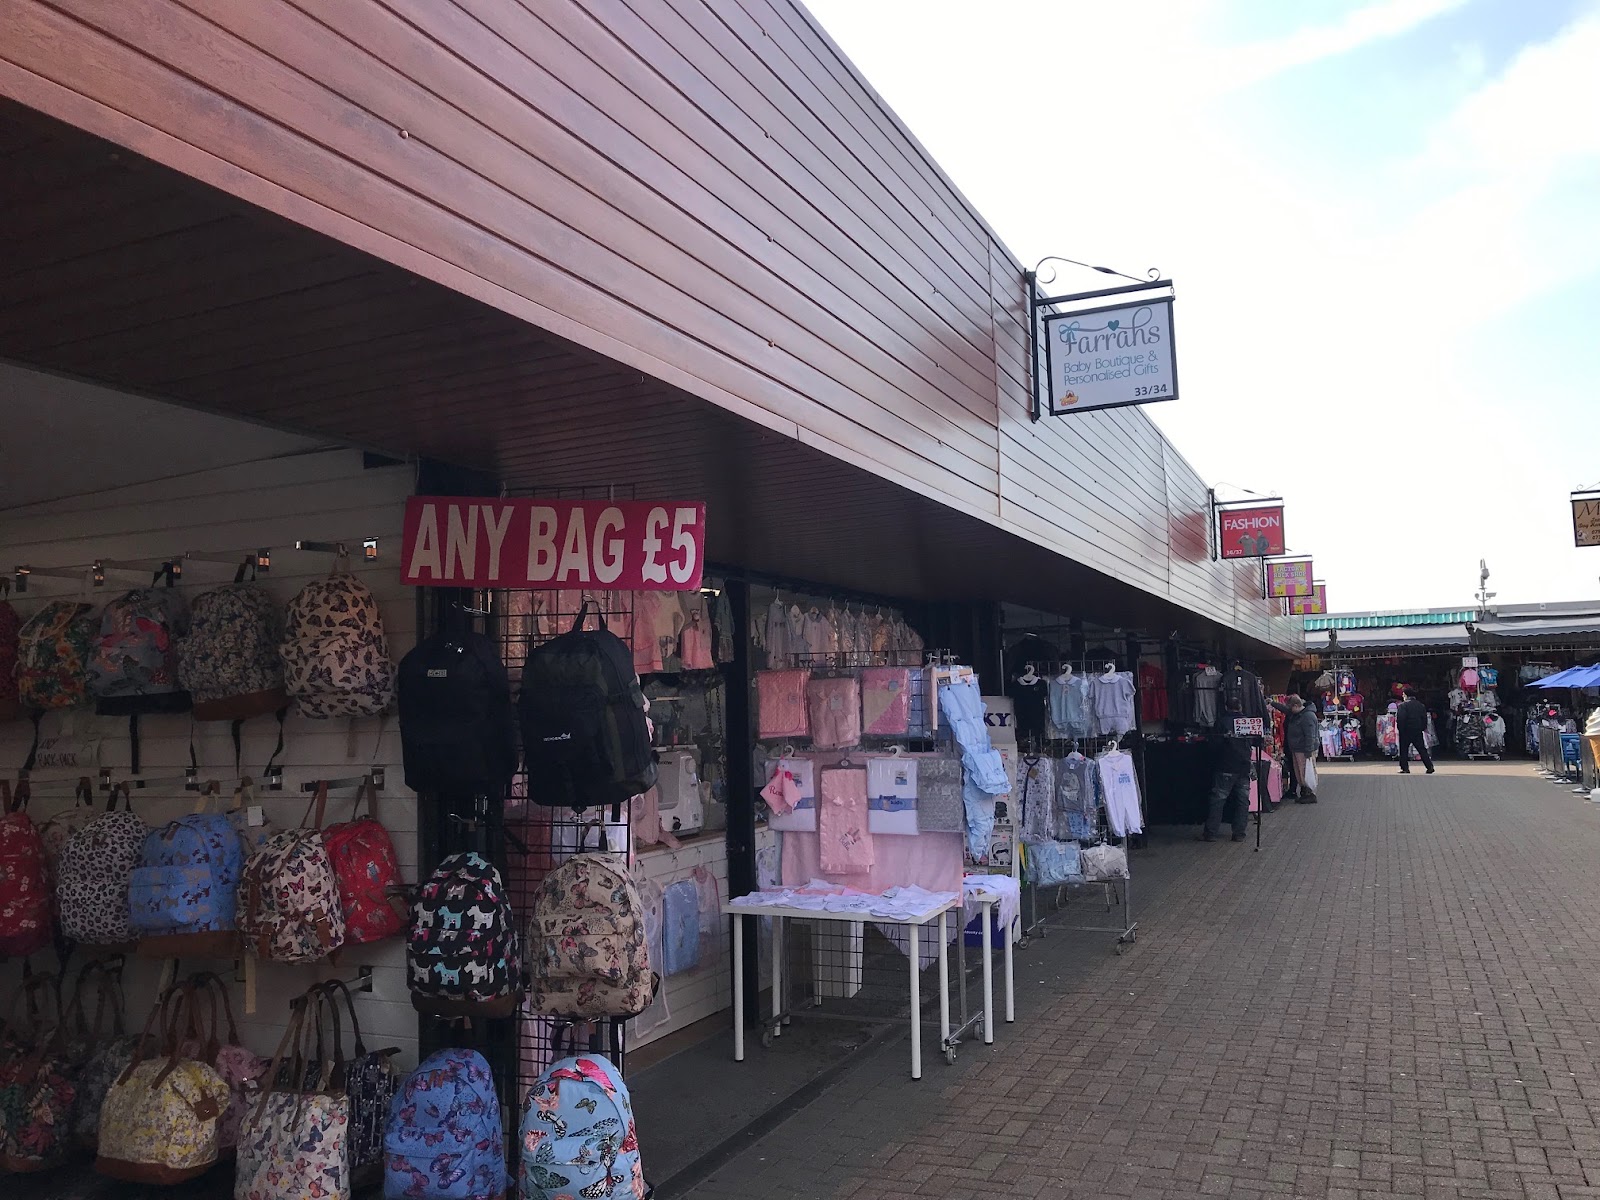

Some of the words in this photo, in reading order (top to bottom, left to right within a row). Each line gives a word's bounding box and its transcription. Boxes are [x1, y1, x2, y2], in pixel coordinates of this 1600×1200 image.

[1059, 307, 1160, 357] Farrahs
[1064, 361, 1091, 374] Baby
[1095, 354, 1144, 370] Boutique
[1148, 350, 1159, 361] &
[1064, 367, 1131, 386] Personalised
[1134, 363, 1159, 376] Gifts
[1134, 383, 1168, 397] 33/34
[1224, 515, 1280, 530] FASHION
[407, 503, 515, 580] ANY
[526, 506, 626, 583] BAG
[641, 506, 698, 584] £5
